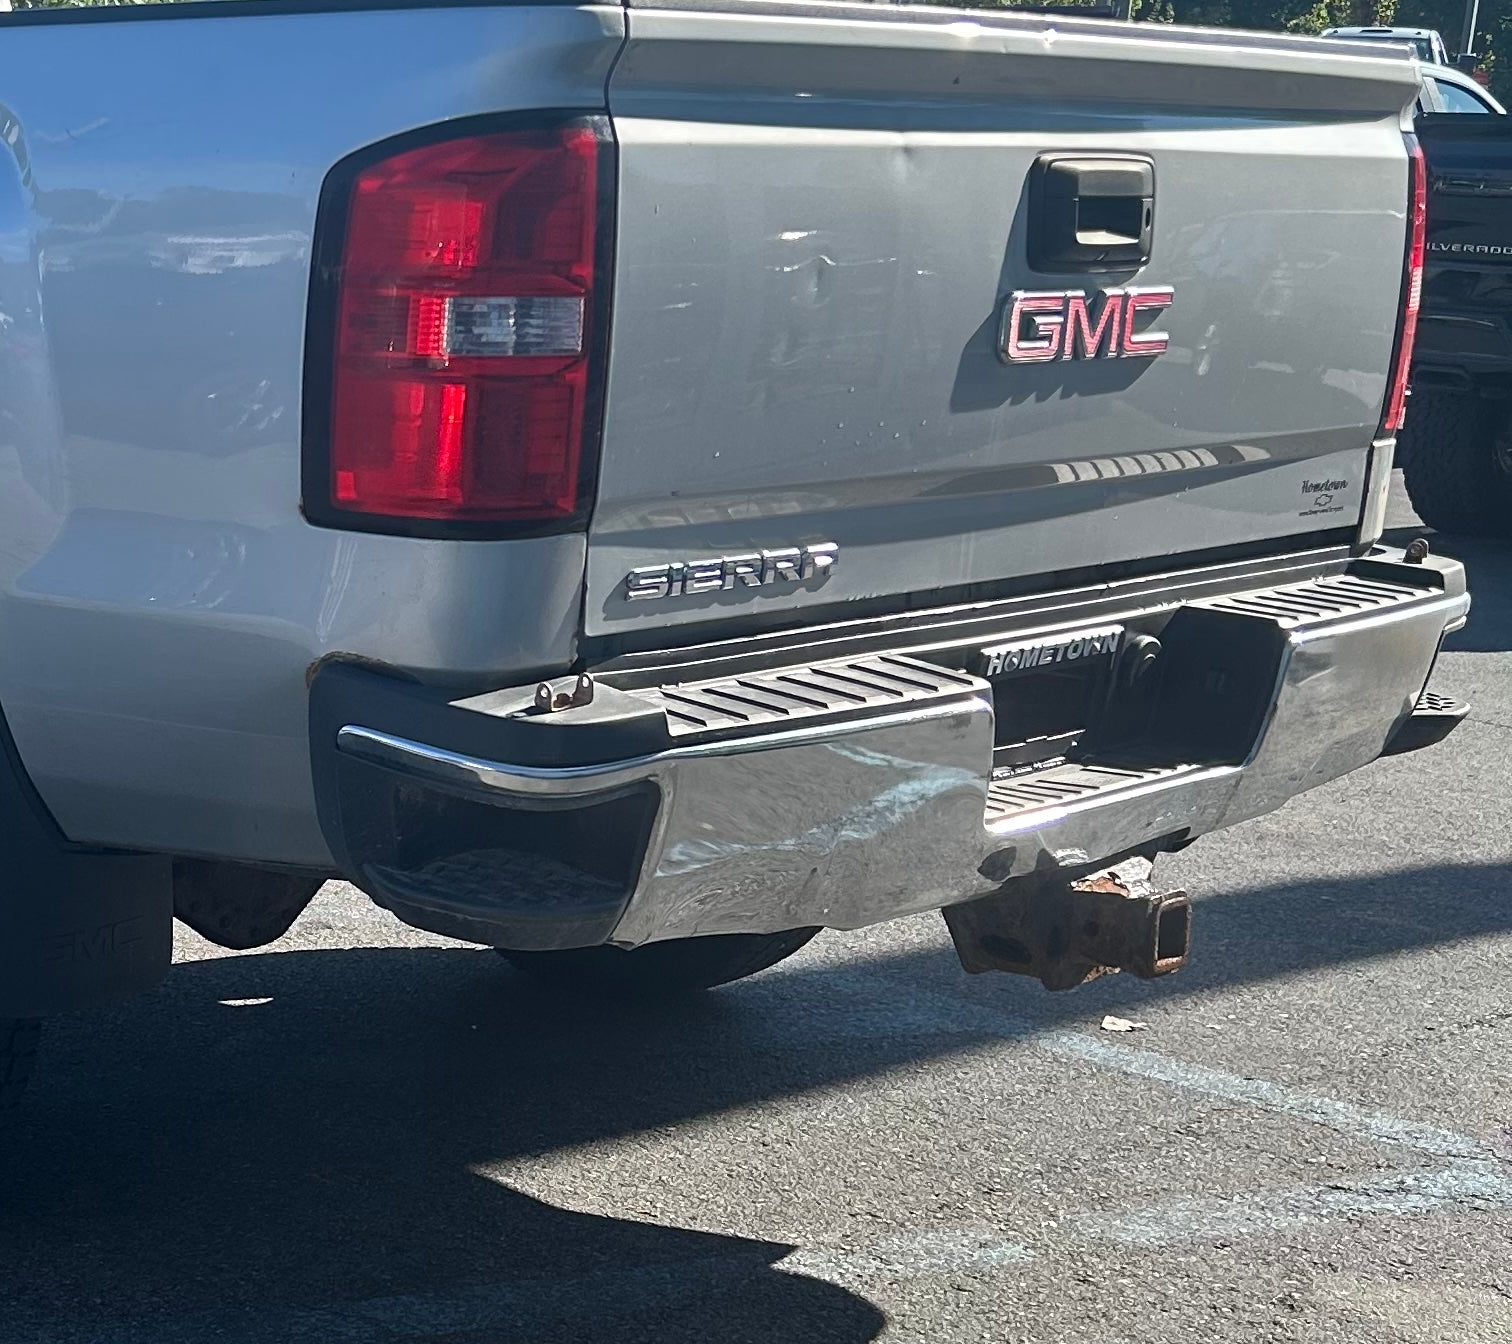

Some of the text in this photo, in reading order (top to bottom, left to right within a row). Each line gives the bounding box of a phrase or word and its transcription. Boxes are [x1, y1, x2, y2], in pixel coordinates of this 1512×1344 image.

[1426, 242, 1512, 255] ILVERADO
[999, 285, 1175, 365] GMC
[1301, 478, 1348, 494] Hometown
[625, 542, 839, 601] SIERRA
[986, 632, 1121, 677] HOMETOWN
